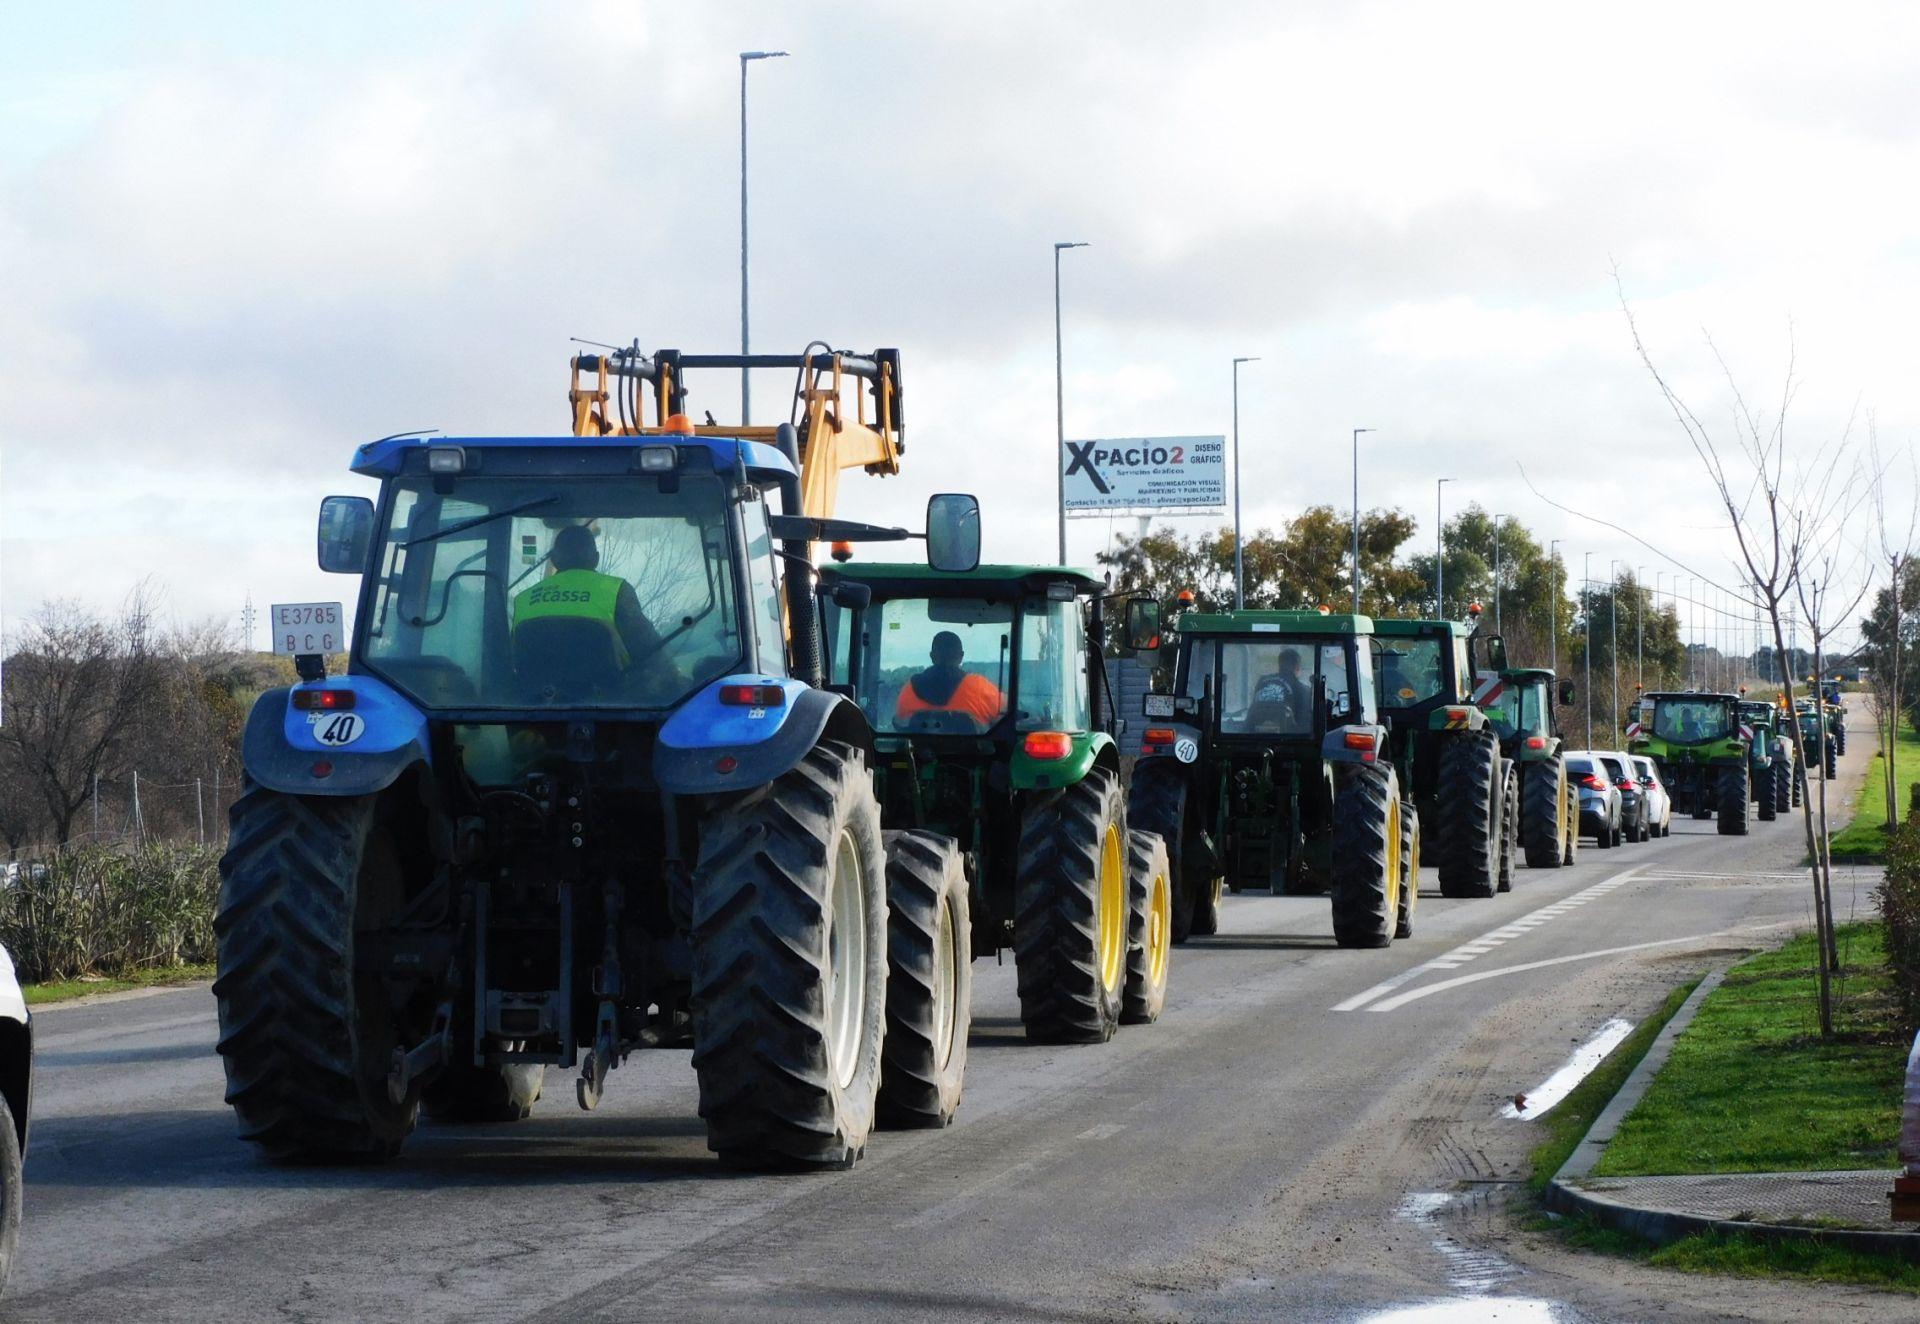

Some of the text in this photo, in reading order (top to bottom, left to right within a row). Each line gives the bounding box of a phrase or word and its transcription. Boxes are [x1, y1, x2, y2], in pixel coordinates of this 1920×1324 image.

[1195, 442, 1221, 452] DISEÑO
[281, 607, 335, 624] E3785
[323, 716, 355, 742] 40
[1178, 742, 1194, 761] 40
